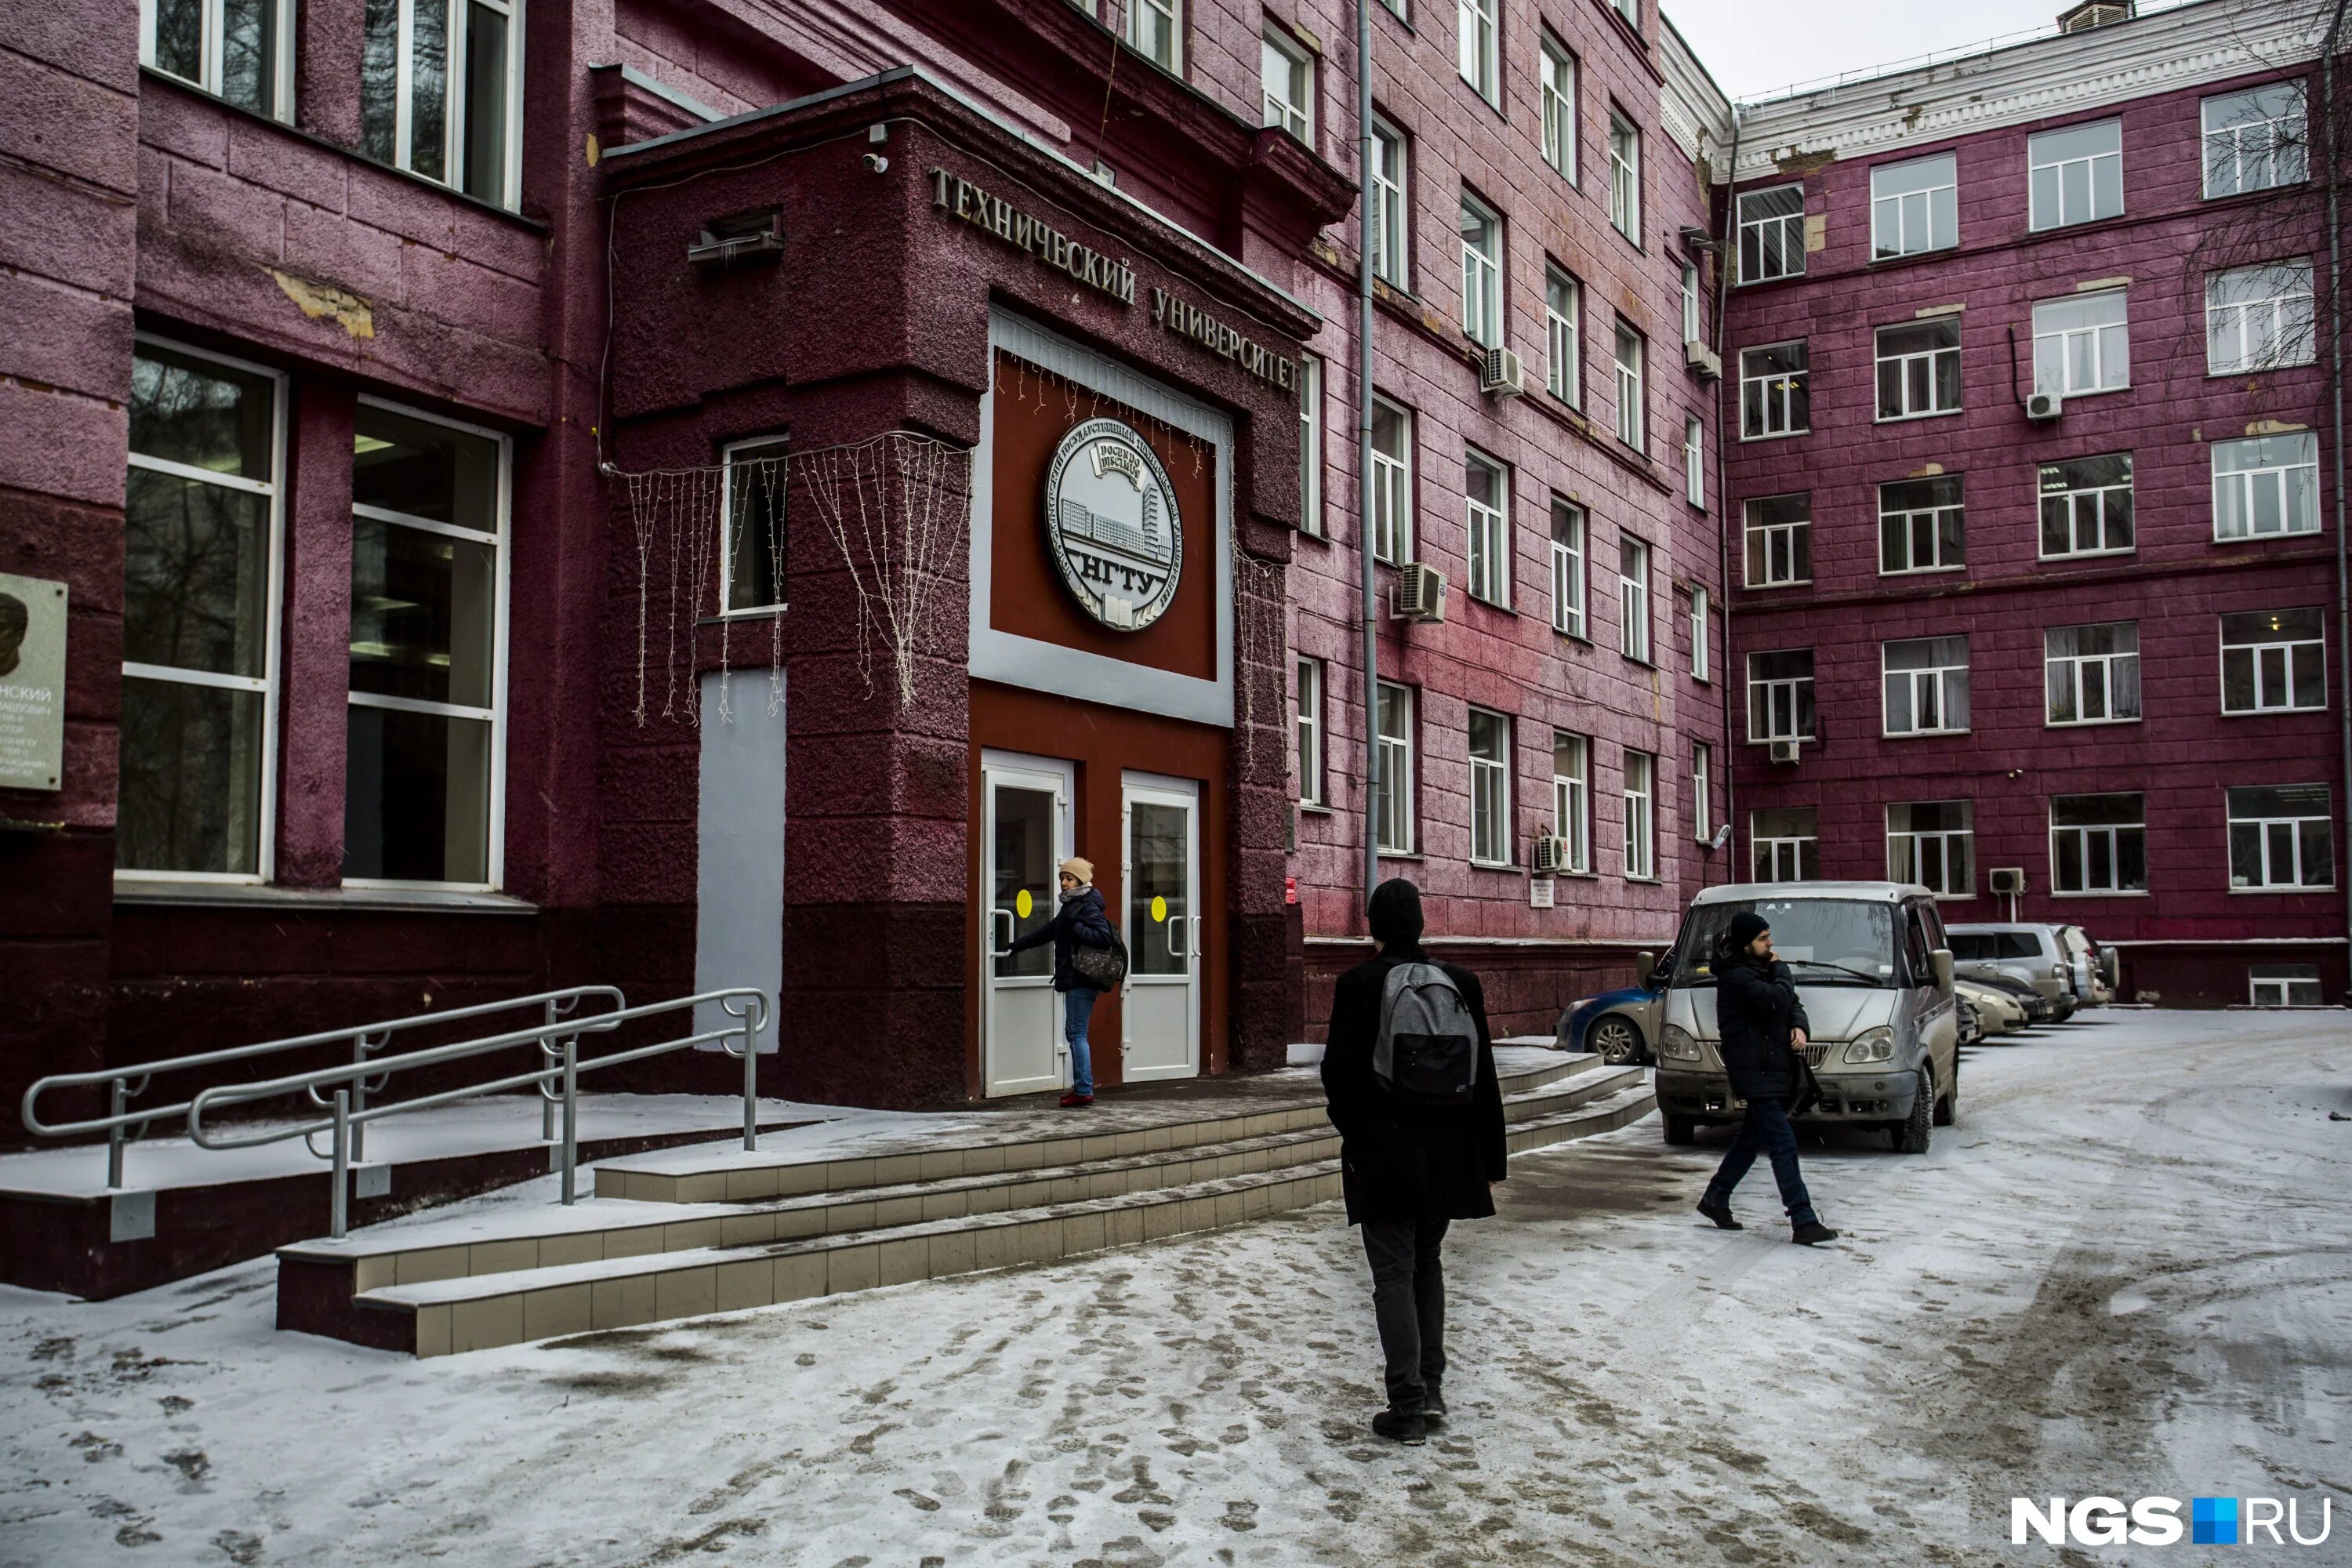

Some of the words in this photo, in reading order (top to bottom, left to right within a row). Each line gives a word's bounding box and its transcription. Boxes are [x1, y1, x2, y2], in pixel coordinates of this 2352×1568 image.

[930, 166, 1136, 307] ТЕХНИЧЕСКИЙ
[1152, 287, 1300, 392] УНИВЕРСИТЕТ
[1061, 421, 1135, 458] ГОСУДАРСТВЕННЫЙ
[1080, 552, 1156, 593] НГТУ
